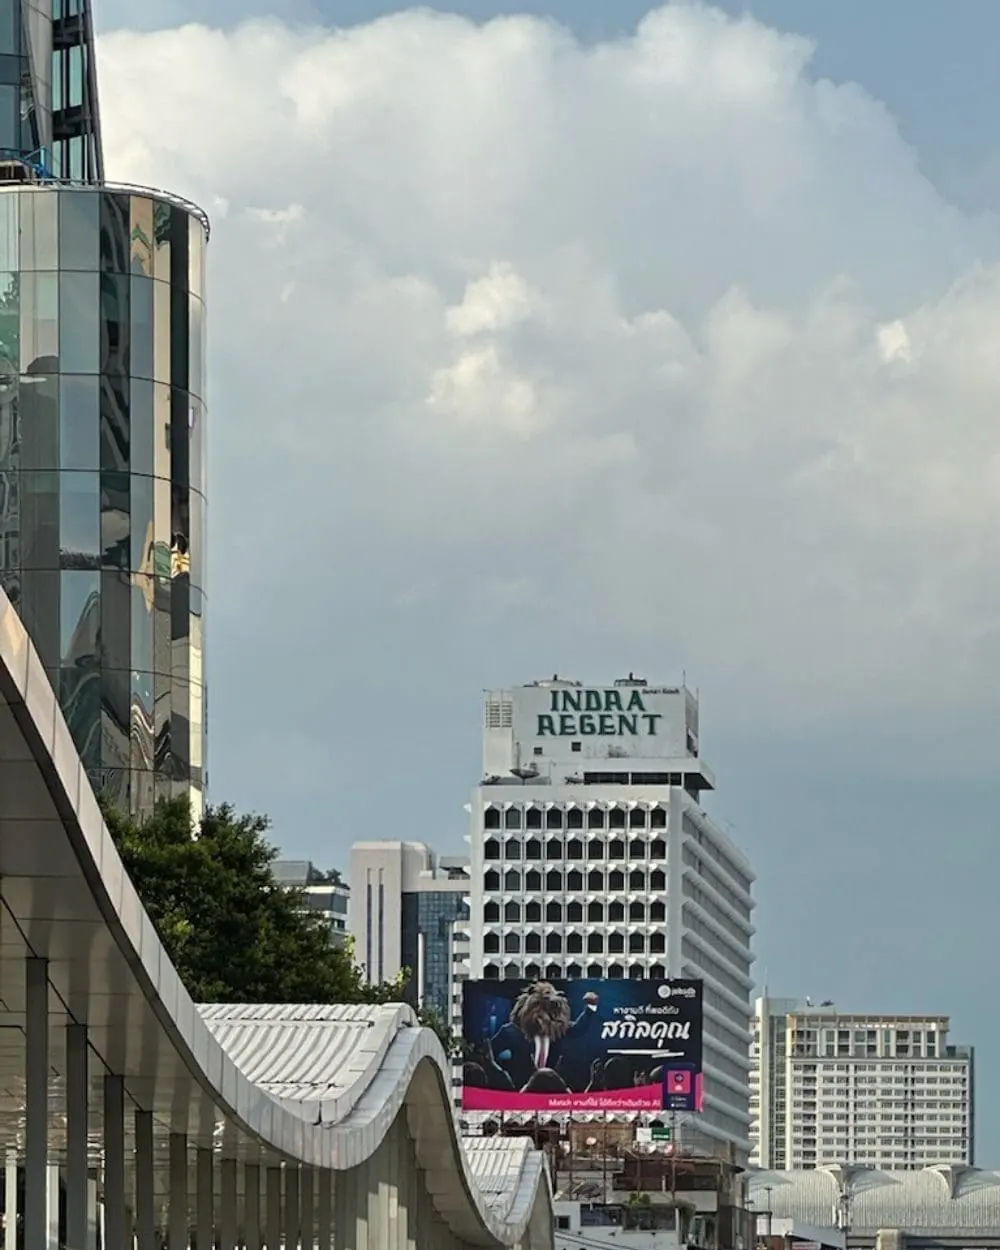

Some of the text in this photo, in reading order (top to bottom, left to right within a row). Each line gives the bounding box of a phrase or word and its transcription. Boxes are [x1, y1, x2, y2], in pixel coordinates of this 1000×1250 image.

[550, 690, 646, 712] INDRA
[536, 714, 662, 736] REGENT
[601, 1014, 690, 1048] สกิลคุณ
